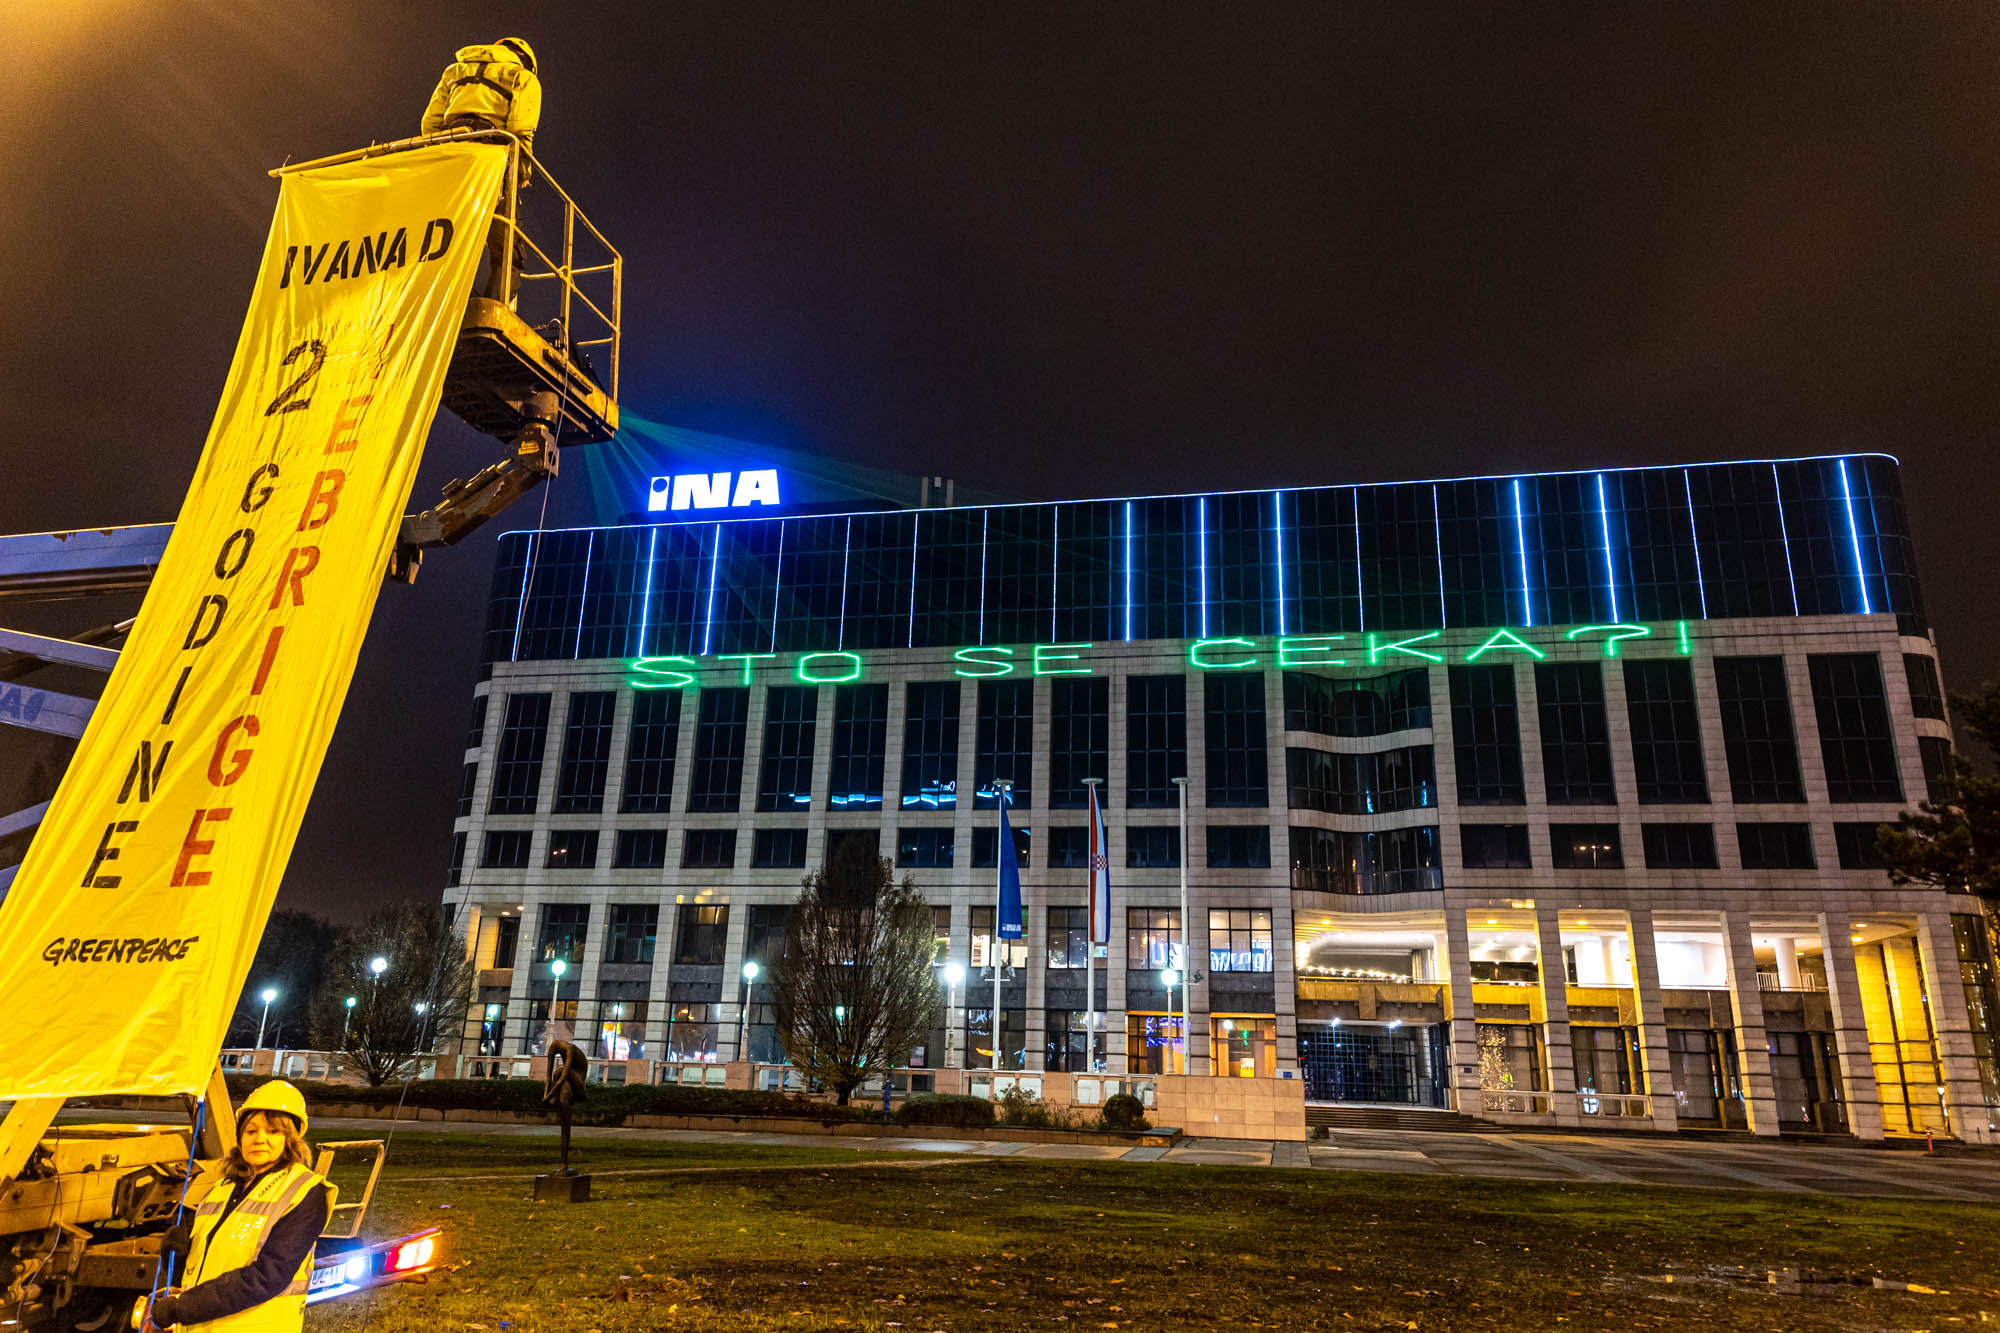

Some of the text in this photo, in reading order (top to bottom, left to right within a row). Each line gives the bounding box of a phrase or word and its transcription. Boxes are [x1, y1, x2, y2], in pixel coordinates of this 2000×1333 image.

[264, 339, 328, 417] 2
[955, 643, 1092, 676] SE
[42, 936, 199, 967] GREENPEACE
